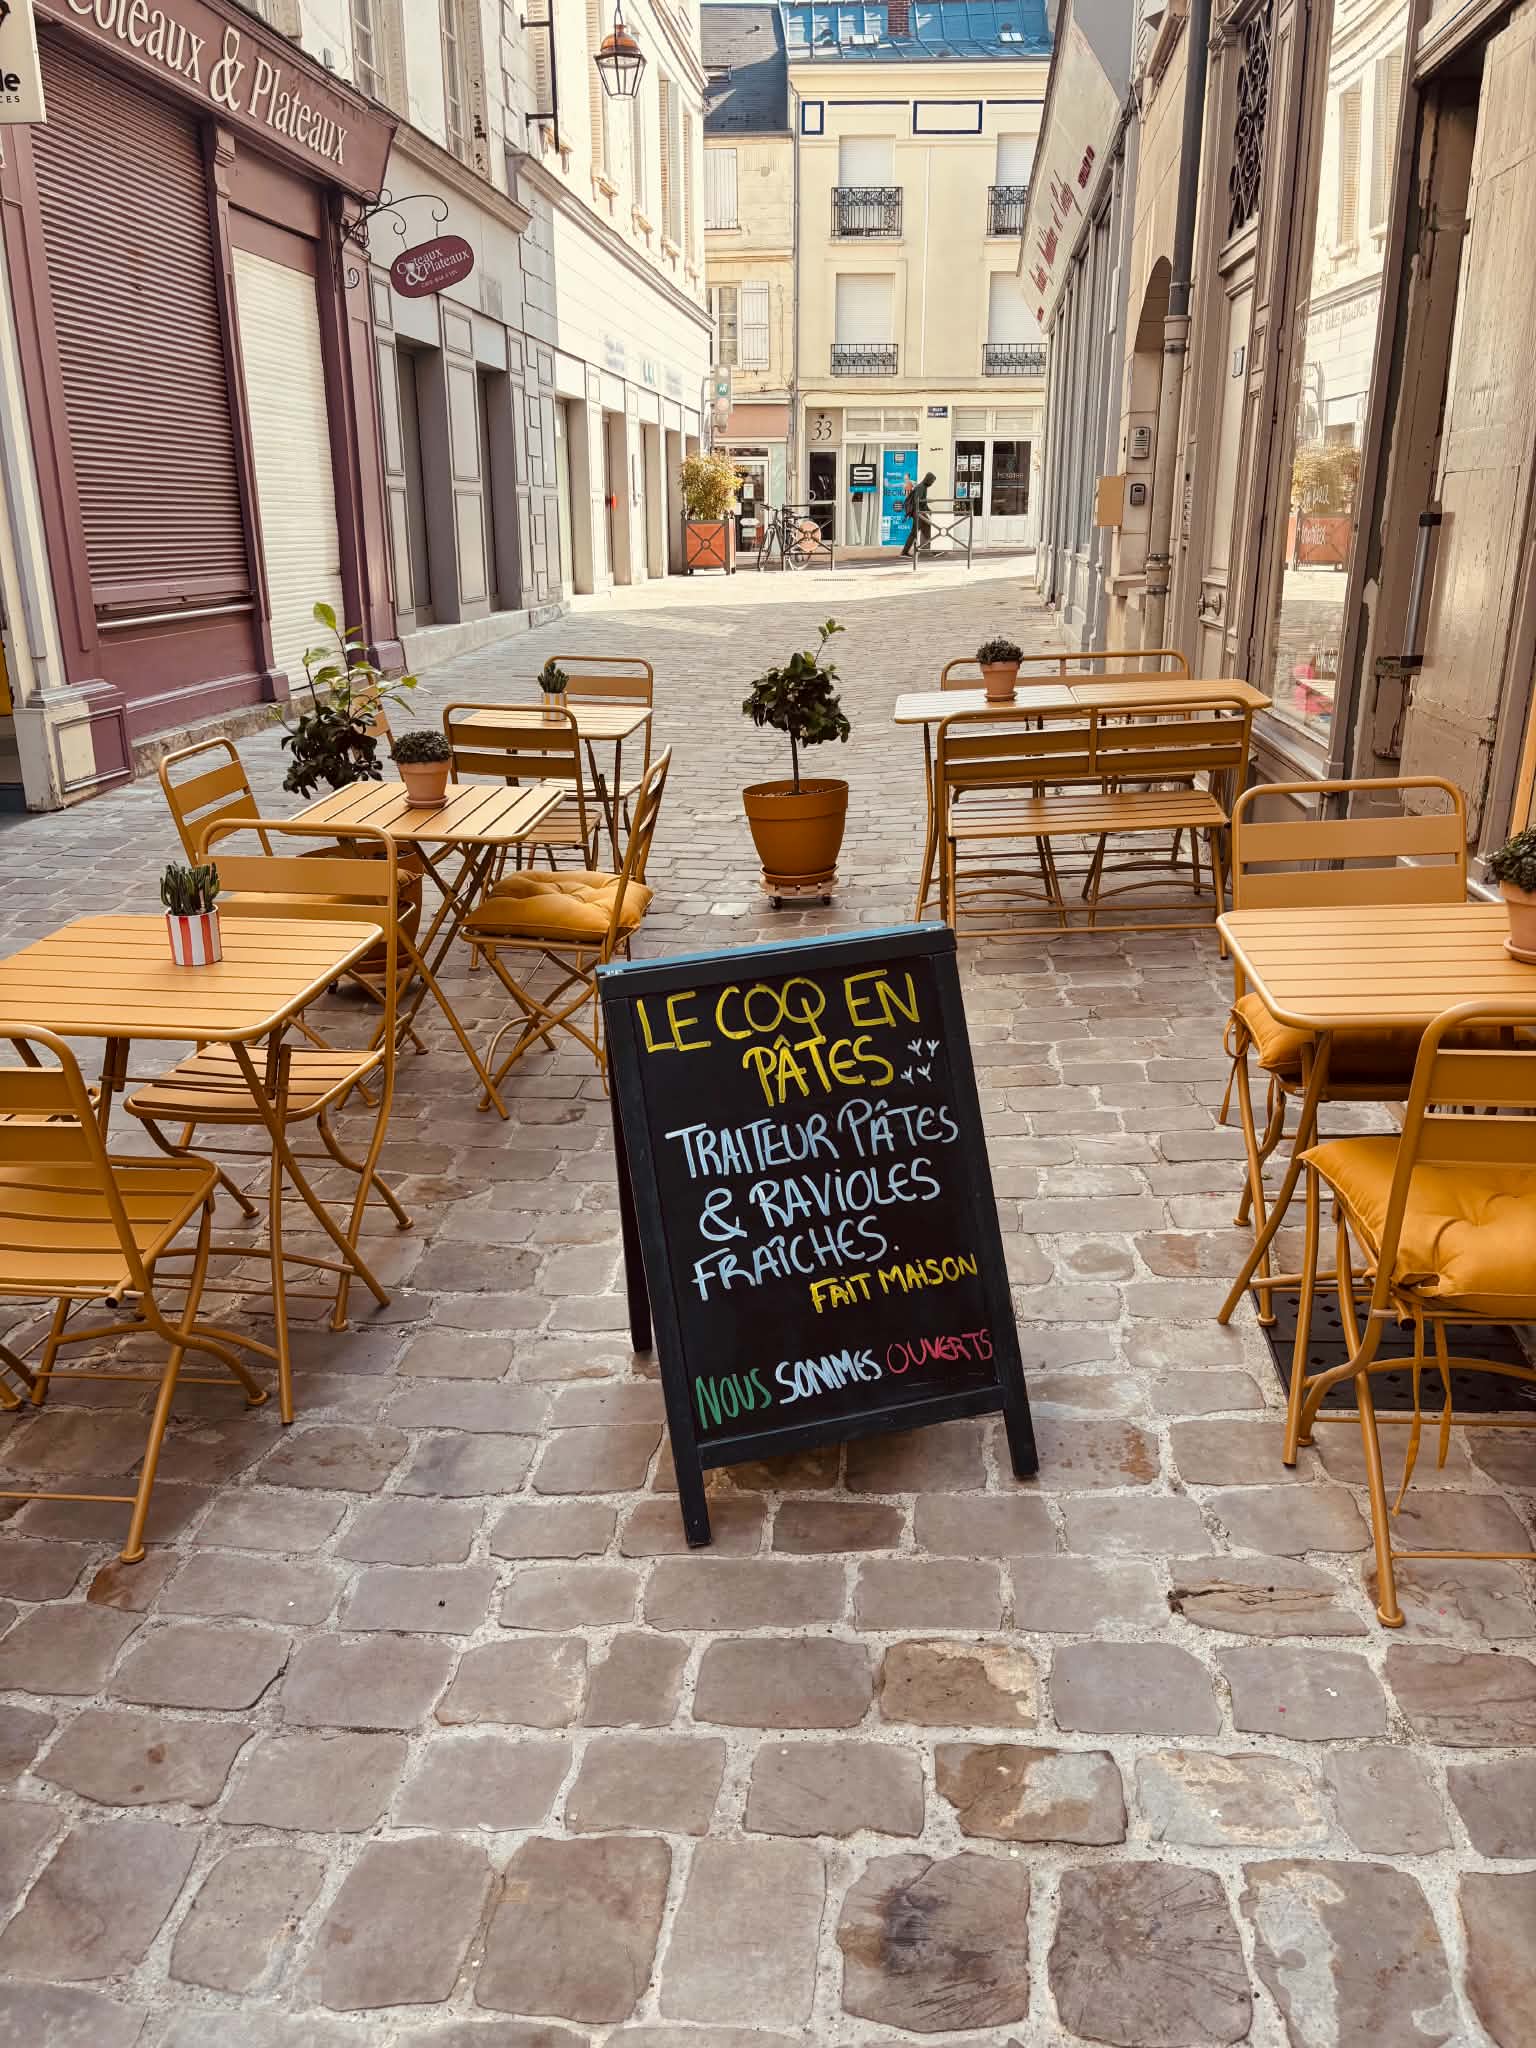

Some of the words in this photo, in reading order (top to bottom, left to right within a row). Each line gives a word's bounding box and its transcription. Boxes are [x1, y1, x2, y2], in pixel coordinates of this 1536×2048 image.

[68, 0, 206, 84] oteaux
[209, 26, 245, 113] &
[248, 56, 349, 166] Plateaux
[423, 249, 470, 275] Plateaux
[811, 420, 833, 441] 33
[637, 991, 711, 1053] LE
[716, 978, 826, 1041] COQ
[844, 970, 919, 1027] EN
[742, 1034, 894, 1107] PÂTES
[665, 1114, 839, 1179] TRAITEUR
[837, 1099, 958, 1160] PÂTES
[699, 1188, 747, 1241] &
[695, 1368, 773, 1430] NOUS
[775, 1349, 882, 1404] SOMMES
[887, 1328, 992, 1375] OUVERTS
